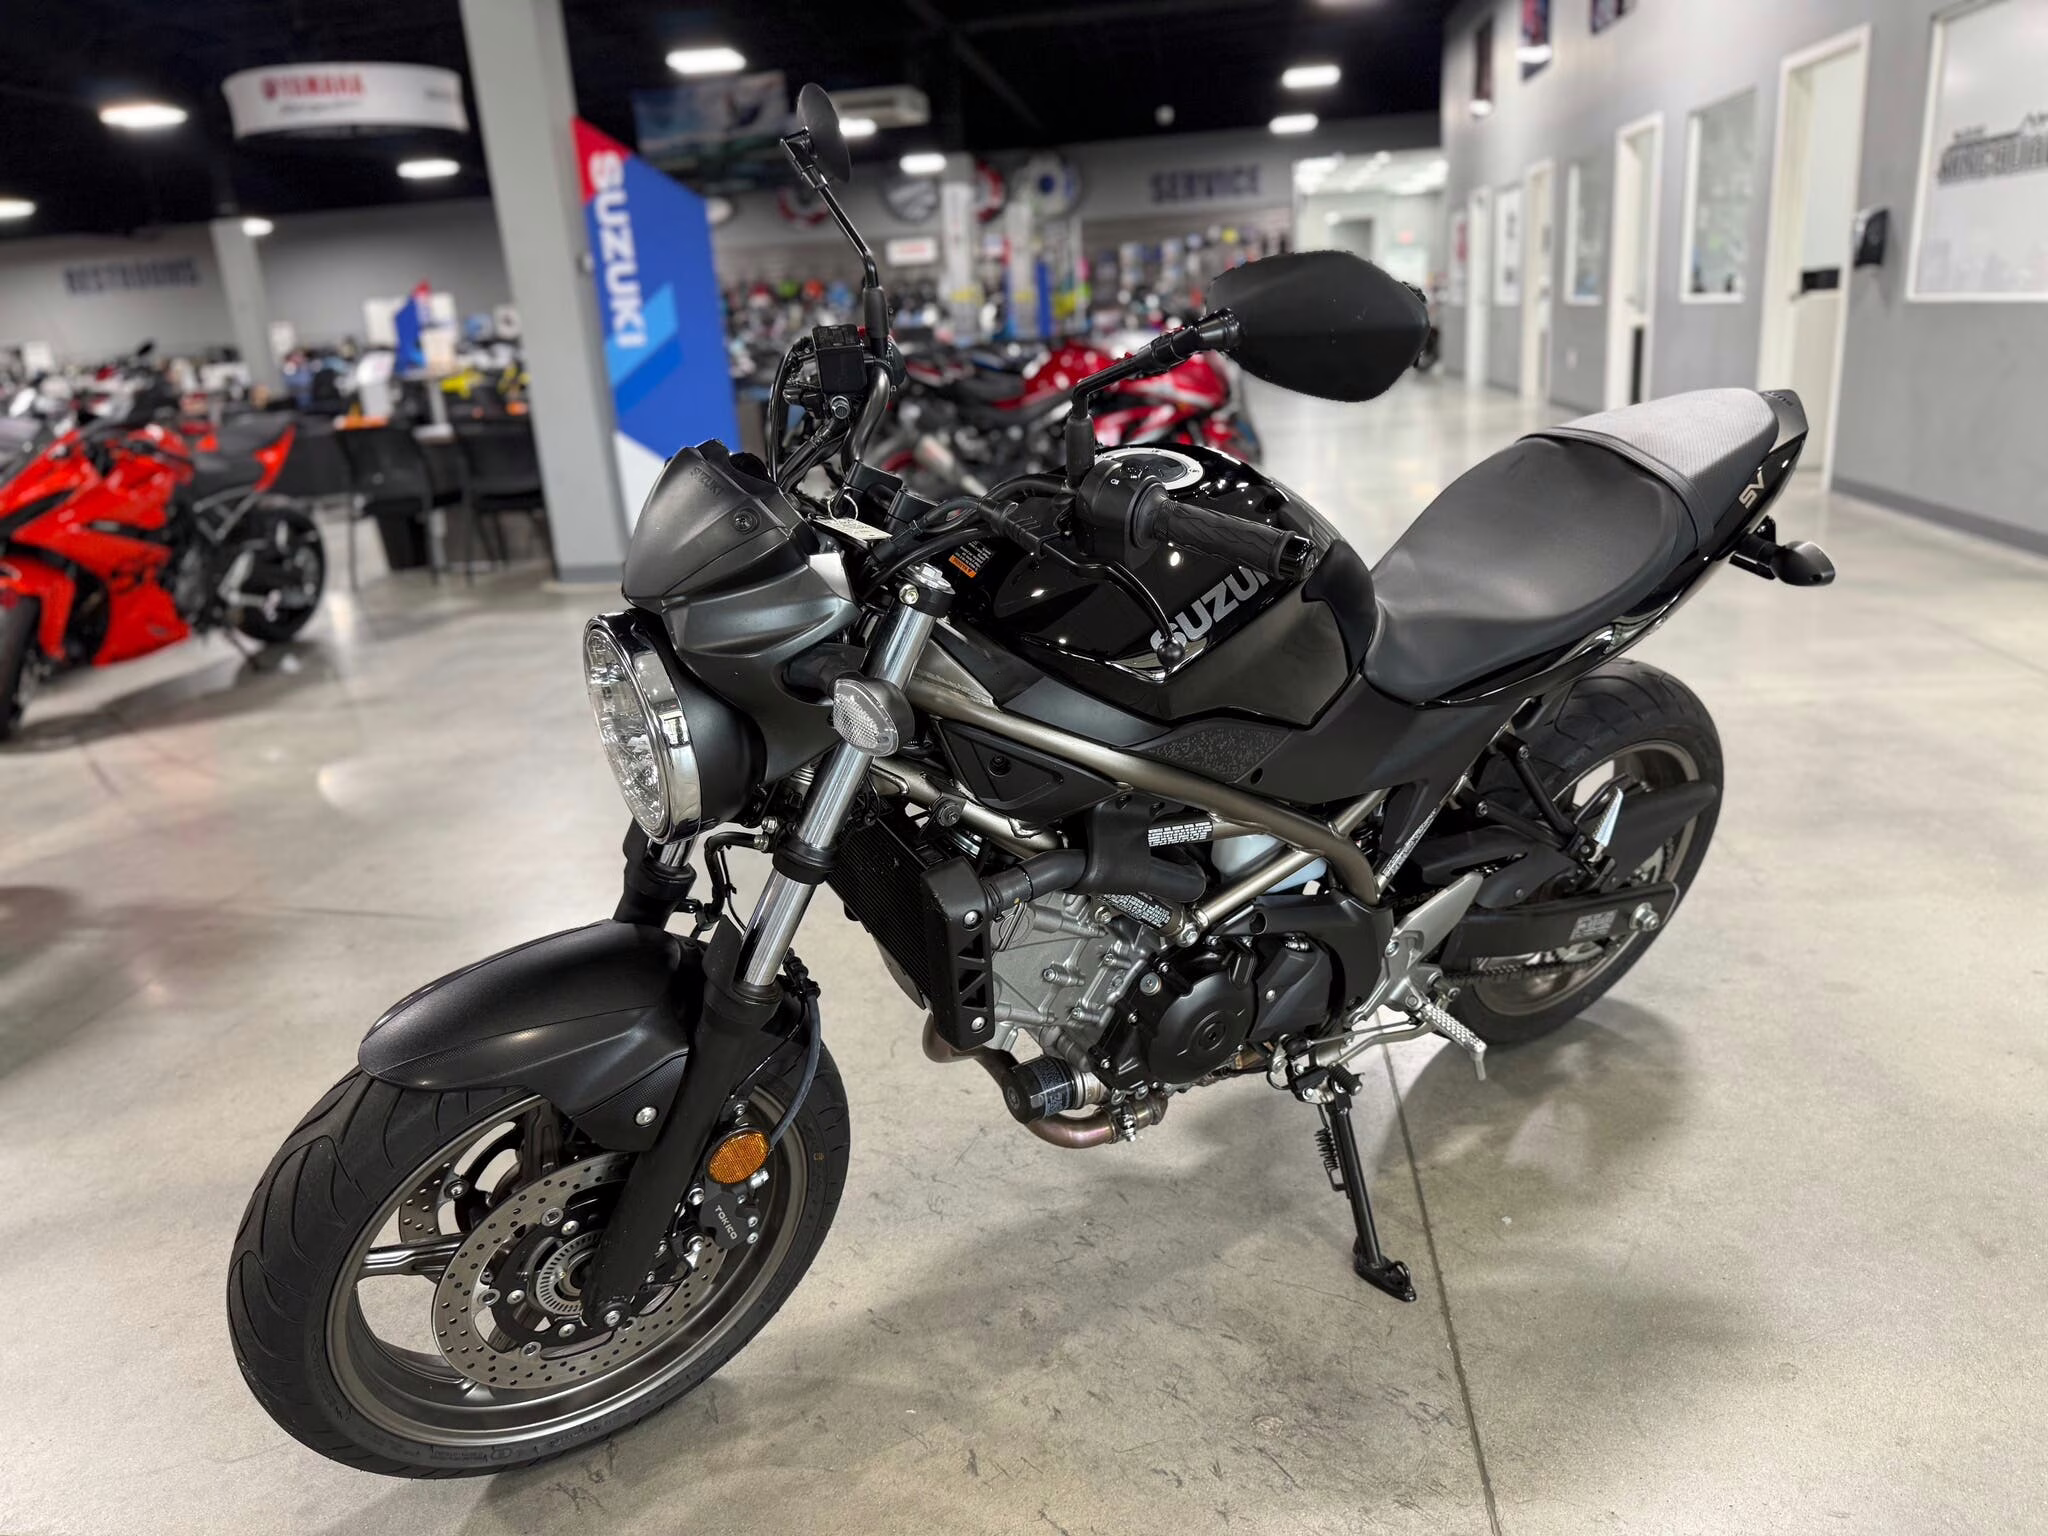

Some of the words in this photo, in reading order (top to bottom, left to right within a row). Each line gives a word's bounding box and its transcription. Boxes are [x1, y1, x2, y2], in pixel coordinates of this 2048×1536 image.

[1150, 165, 1261, 204] SERVICE
[588, 151, 647, 348] SUZUKI
[1738, 470, 1765, 509] SV
[715, 1204, 738, 1240] TOKICO
